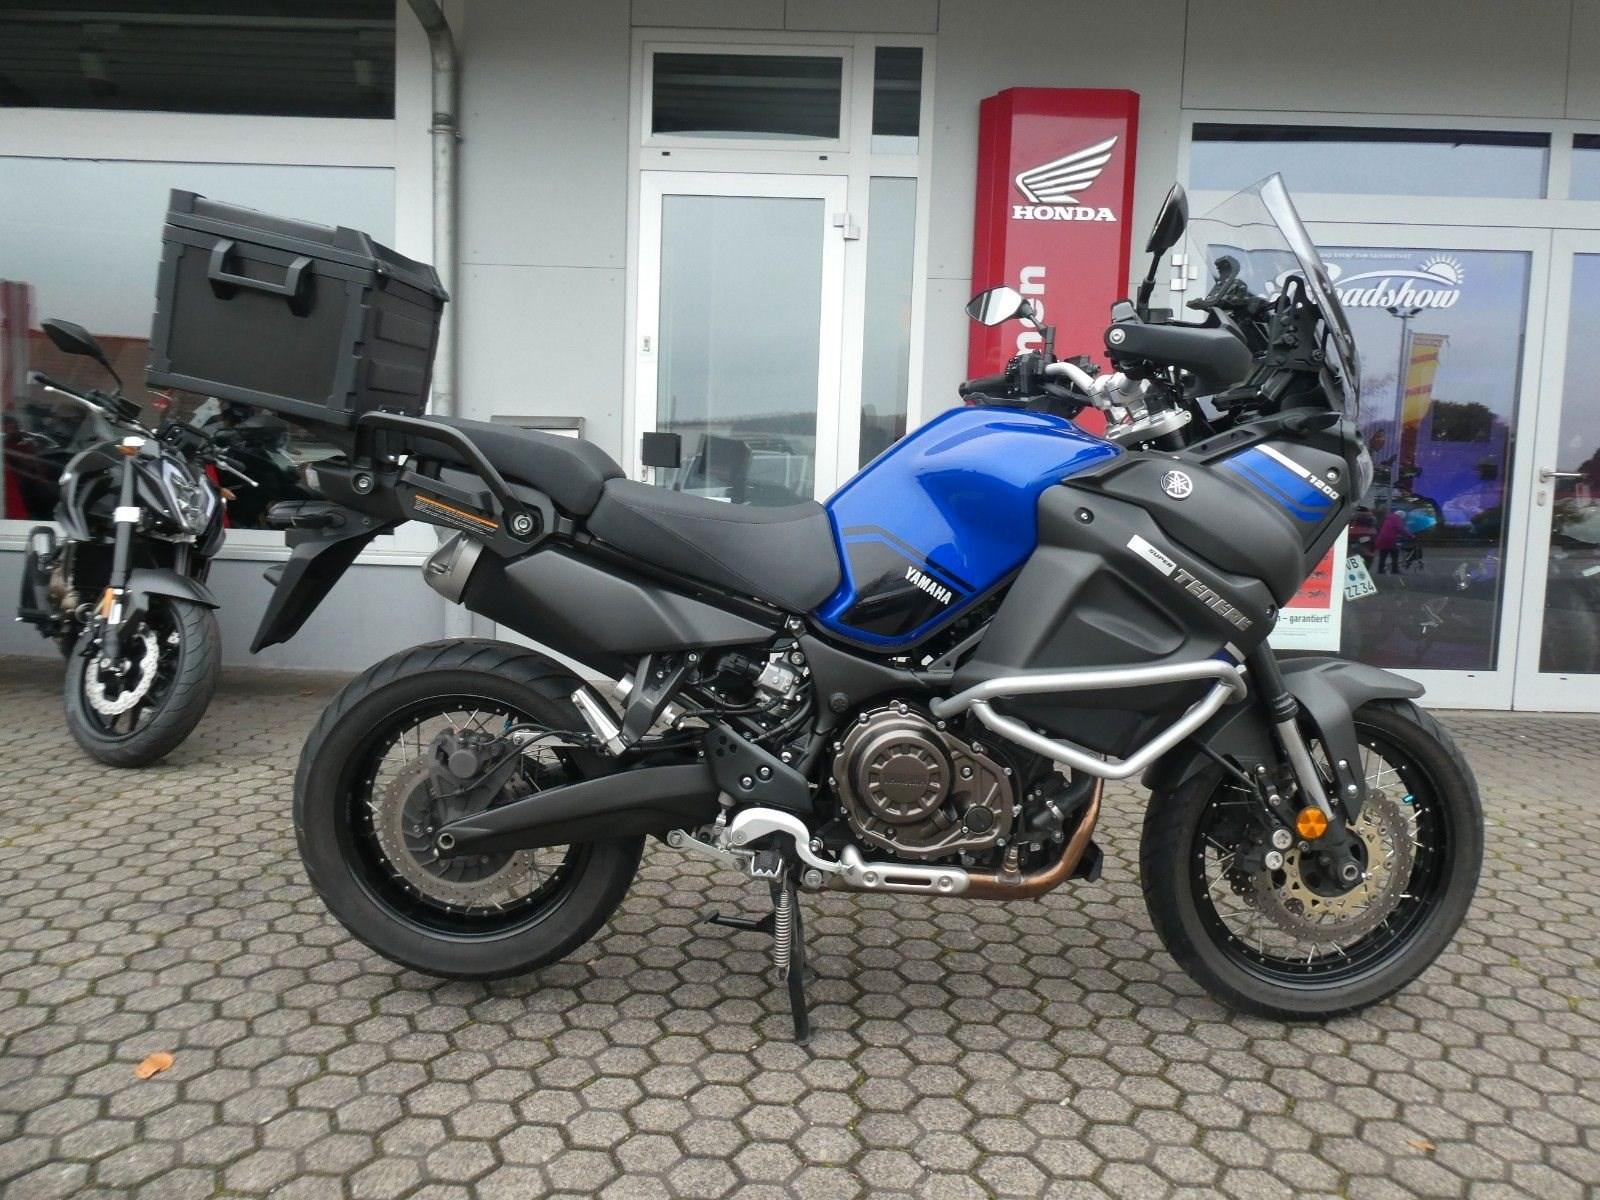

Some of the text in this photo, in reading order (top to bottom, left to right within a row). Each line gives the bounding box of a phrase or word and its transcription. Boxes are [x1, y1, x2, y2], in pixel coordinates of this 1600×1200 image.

[1012, 205, 1118, 222] HONDA
[1307, 475, 1340, 500] 1200
[1148, 548, 1174, 568] SUPER
[904, 566, 953, 605] YAMAHA
